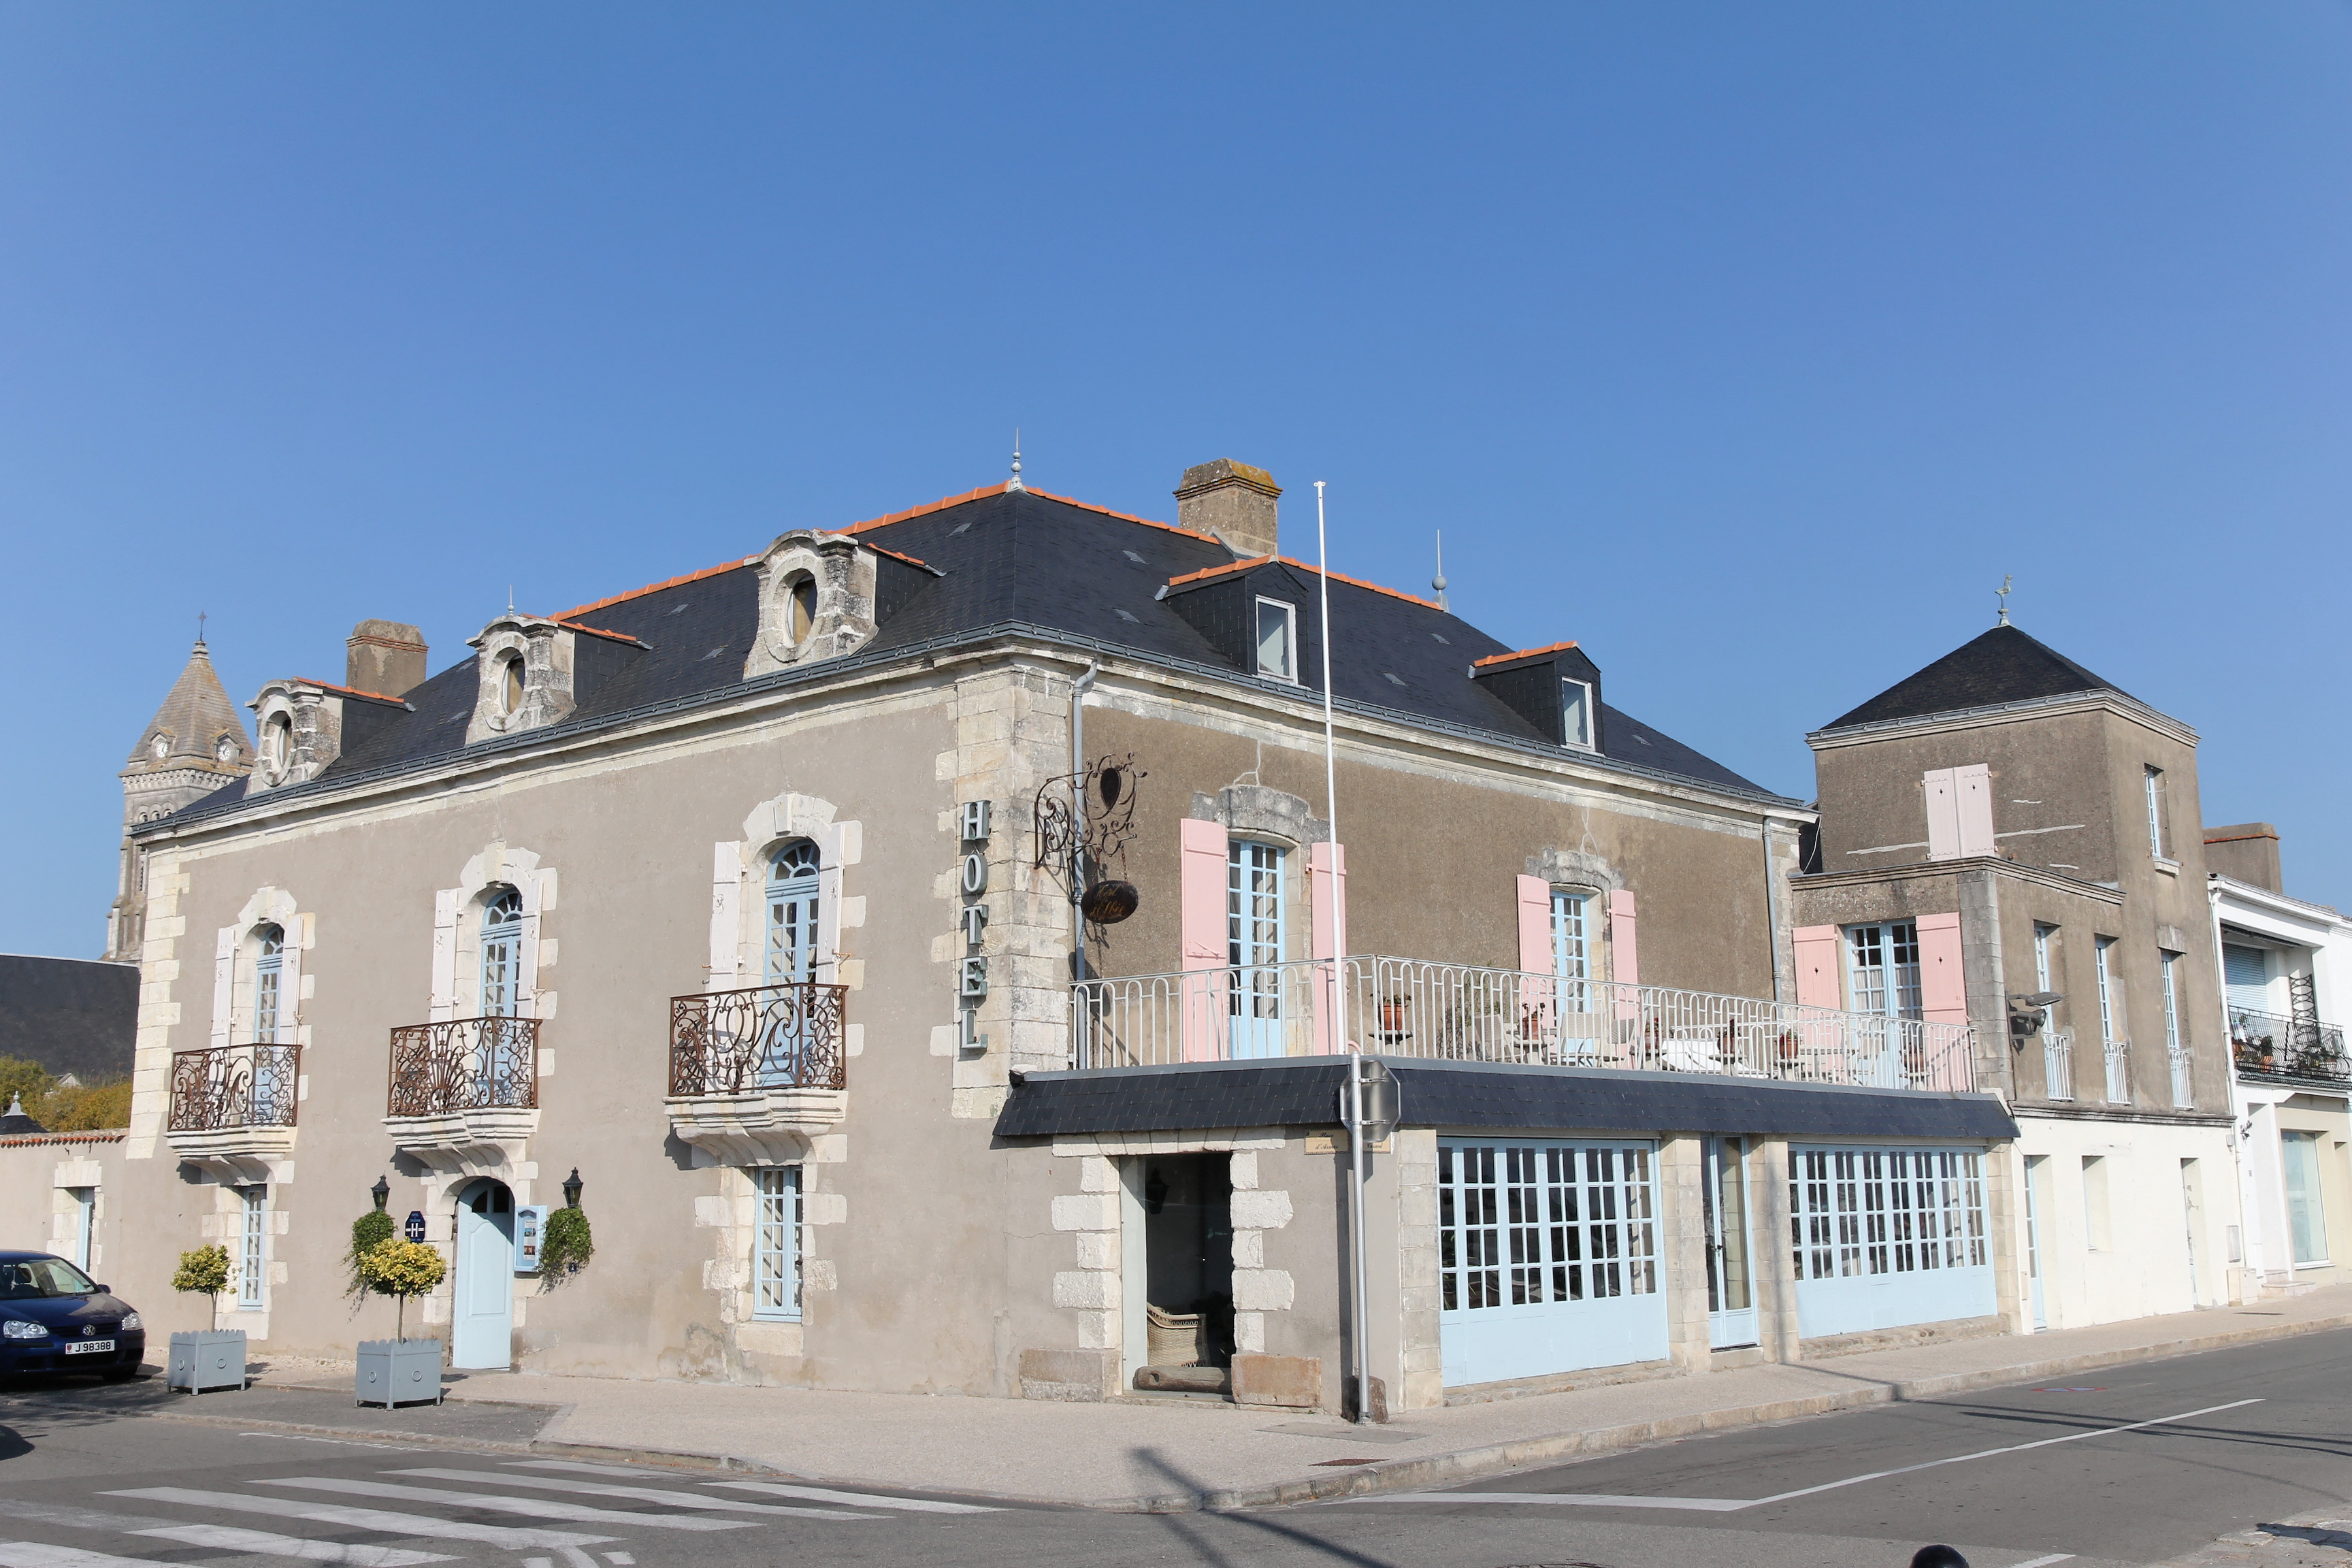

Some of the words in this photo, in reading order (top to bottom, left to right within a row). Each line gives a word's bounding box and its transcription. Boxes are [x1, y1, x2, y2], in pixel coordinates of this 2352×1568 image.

[961, 800, 992, 1049] HOTEL
[410, 1222, 419, 1237] H
[76, 1343, 81, 1352] J
[83, 1341, 111, 1352] 98388
